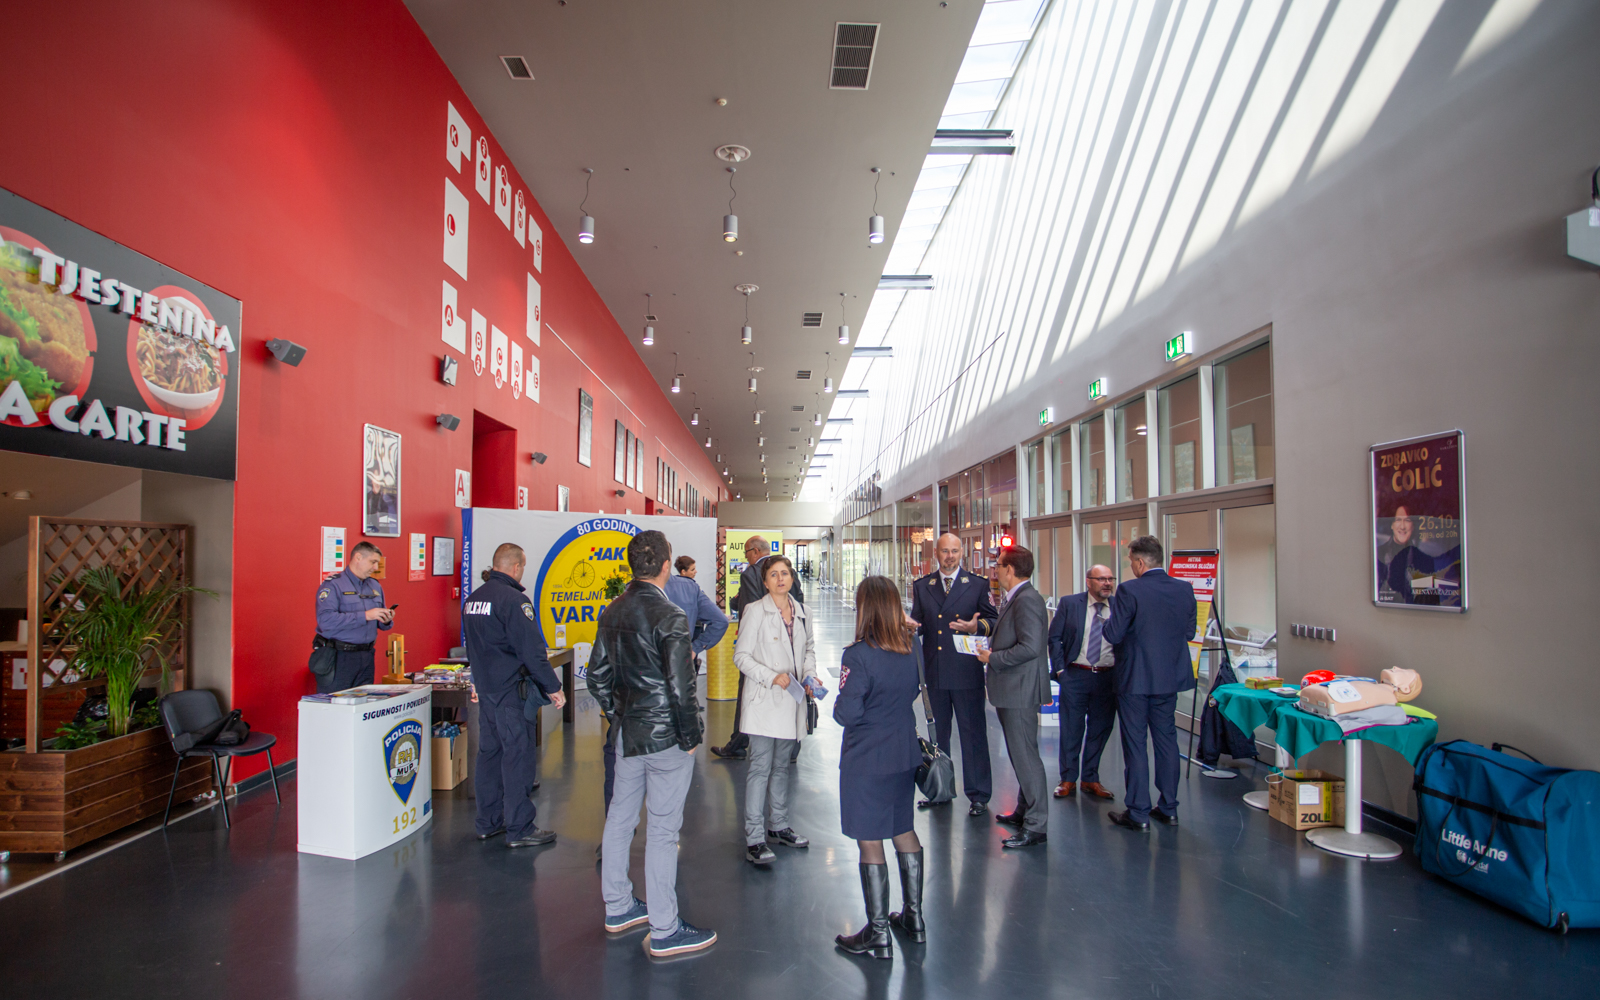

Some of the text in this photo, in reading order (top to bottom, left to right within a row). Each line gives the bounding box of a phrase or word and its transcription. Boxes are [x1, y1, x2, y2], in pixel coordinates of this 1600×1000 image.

[451, 127, 458, 146] K
[33, 247, 236, 353] TJESTENINA
[0, 380, 186, 451] A CARTE
[1381, 447, 1428, 468] ZDRAVKO
[1392, 458, 1442, 492] ČOLIĆ
[457, 473, 465, 497] A
[519, 489, 524, 507] B
[577, 519, 636, 537] 80 GODINA
[1418, 514, 1457, 530] 26.10.
[1436, 530, 1444, 539] od
[1446, 530, 1458, 538] 20h
[589, 547, 626, 560] HAK
[551, 590, 602, 602] TEMELJNI
[551, 605, 606, 623] VARA
[578, 666, 588, 677] 19
[362, 704, 402, 721] SIGURNOST
[384, 724, 422, 748] POLICIJA
[396, 764, 414, 776] MUP
[393, 807, 417, 834] 192
[1301, 813, 1330, 823] ZOL
[1442, 828, 1472, 849] Little
[1468, 857, 1489, 870] Ladal
